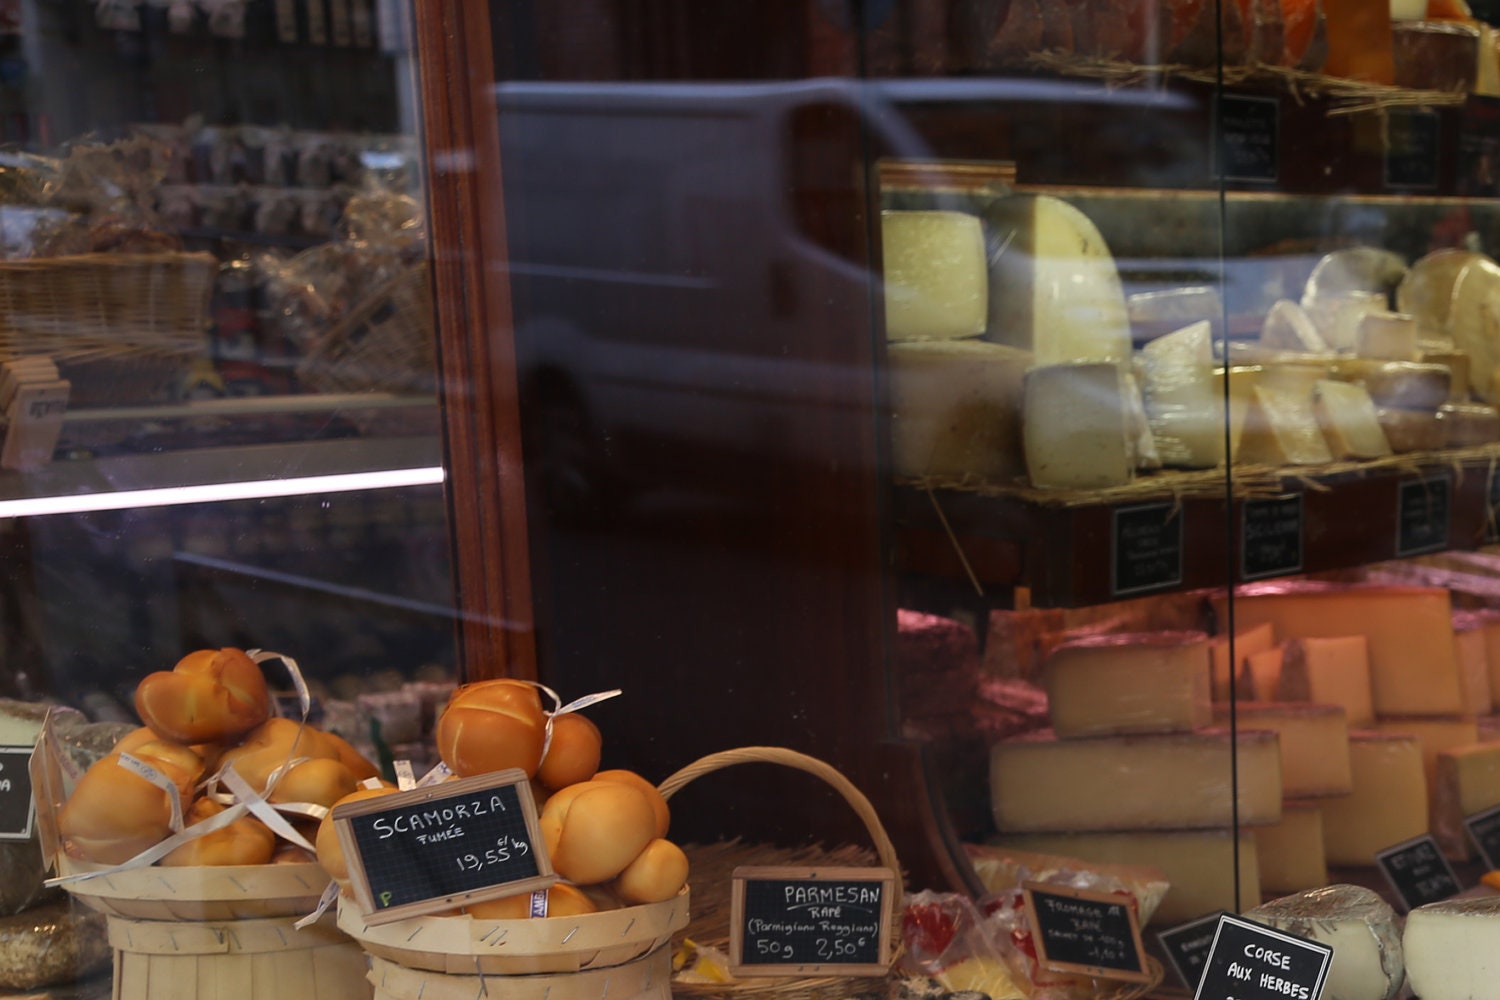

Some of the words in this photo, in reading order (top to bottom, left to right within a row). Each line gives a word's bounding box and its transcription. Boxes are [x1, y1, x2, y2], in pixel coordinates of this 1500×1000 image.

[373, 795, 506, 840] SCAMORZA
[785, 886, 880, 904] PARMESAN
[1244, 944, 1291, 971] CORSE
[1227, 962, 1252, 981] AUX
[1260, 973, 1310, 1000] HERBES
